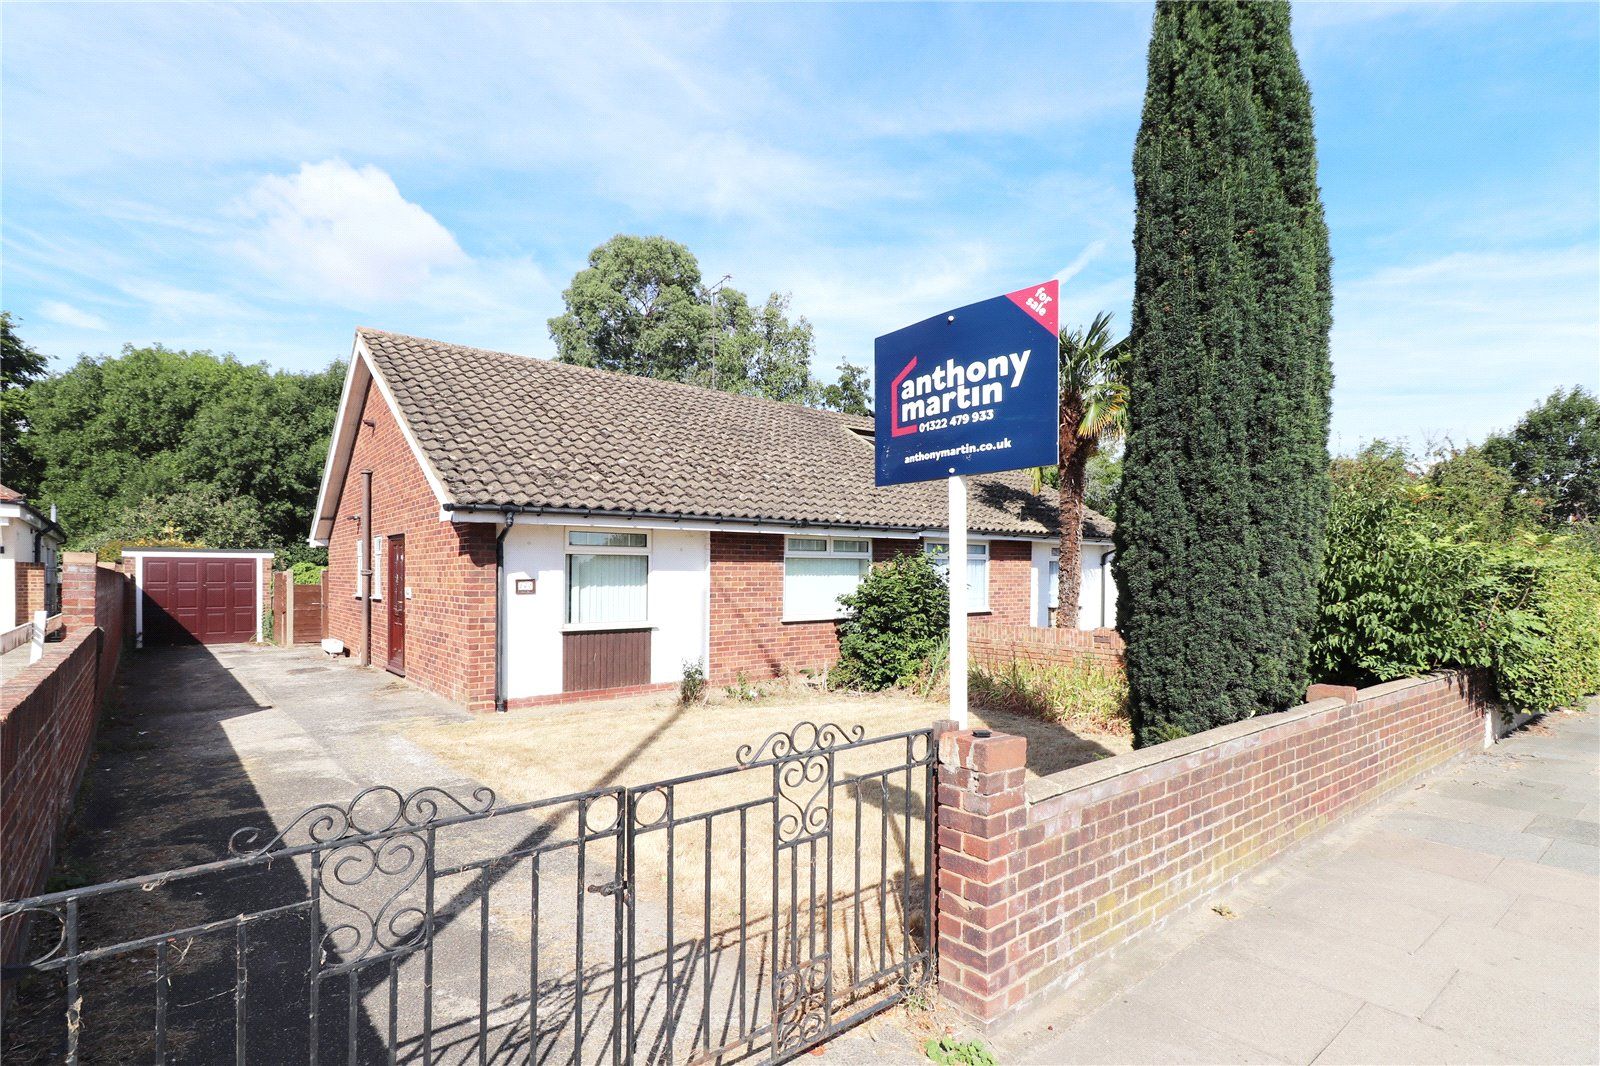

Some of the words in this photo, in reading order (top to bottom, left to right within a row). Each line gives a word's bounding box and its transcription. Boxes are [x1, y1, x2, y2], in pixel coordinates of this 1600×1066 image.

[1025, 297, 1046, 316] sale
[1035, 287, 1052, 303] for
[901, 349, 1031, 400] anthony
[901, 381, 1003, 423] martin
[919, 419, 948, 433] 01322
[949, 414, 970, 426] 479
[971, 409, 995, 423] 933
[904, 437, 1012, 464] anthonymartin.co.uk
